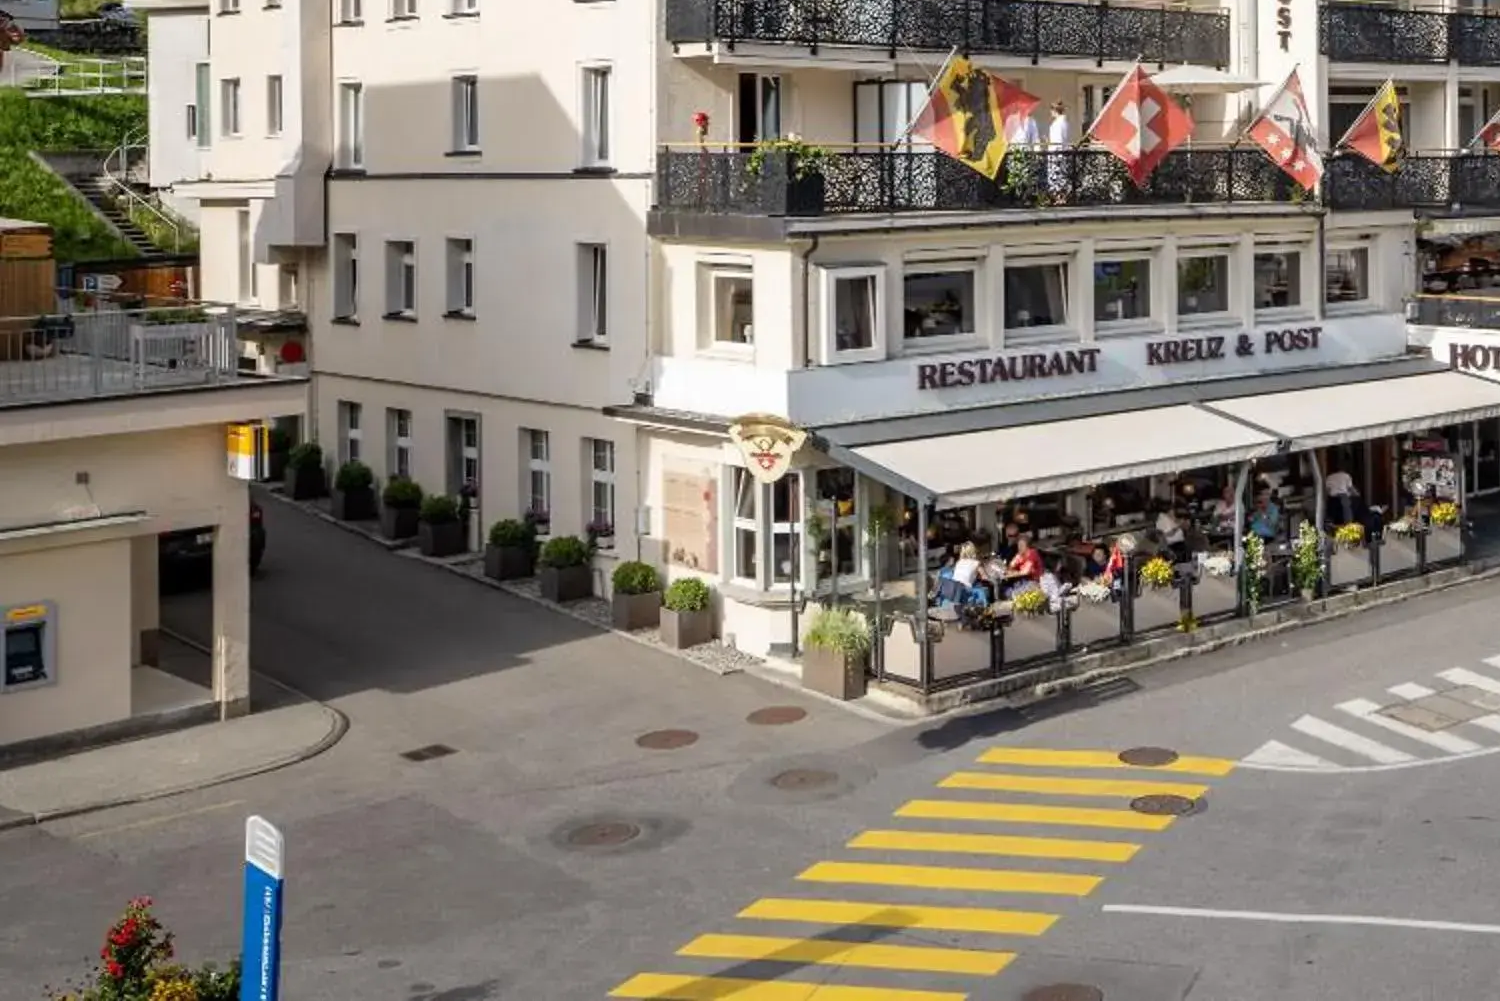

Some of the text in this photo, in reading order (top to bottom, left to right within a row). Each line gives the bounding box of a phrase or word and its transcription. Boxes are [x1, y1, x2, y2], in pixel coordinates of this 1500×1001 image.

[917, 327, 1323, 390] RESTAURANT KREUZ & POST
